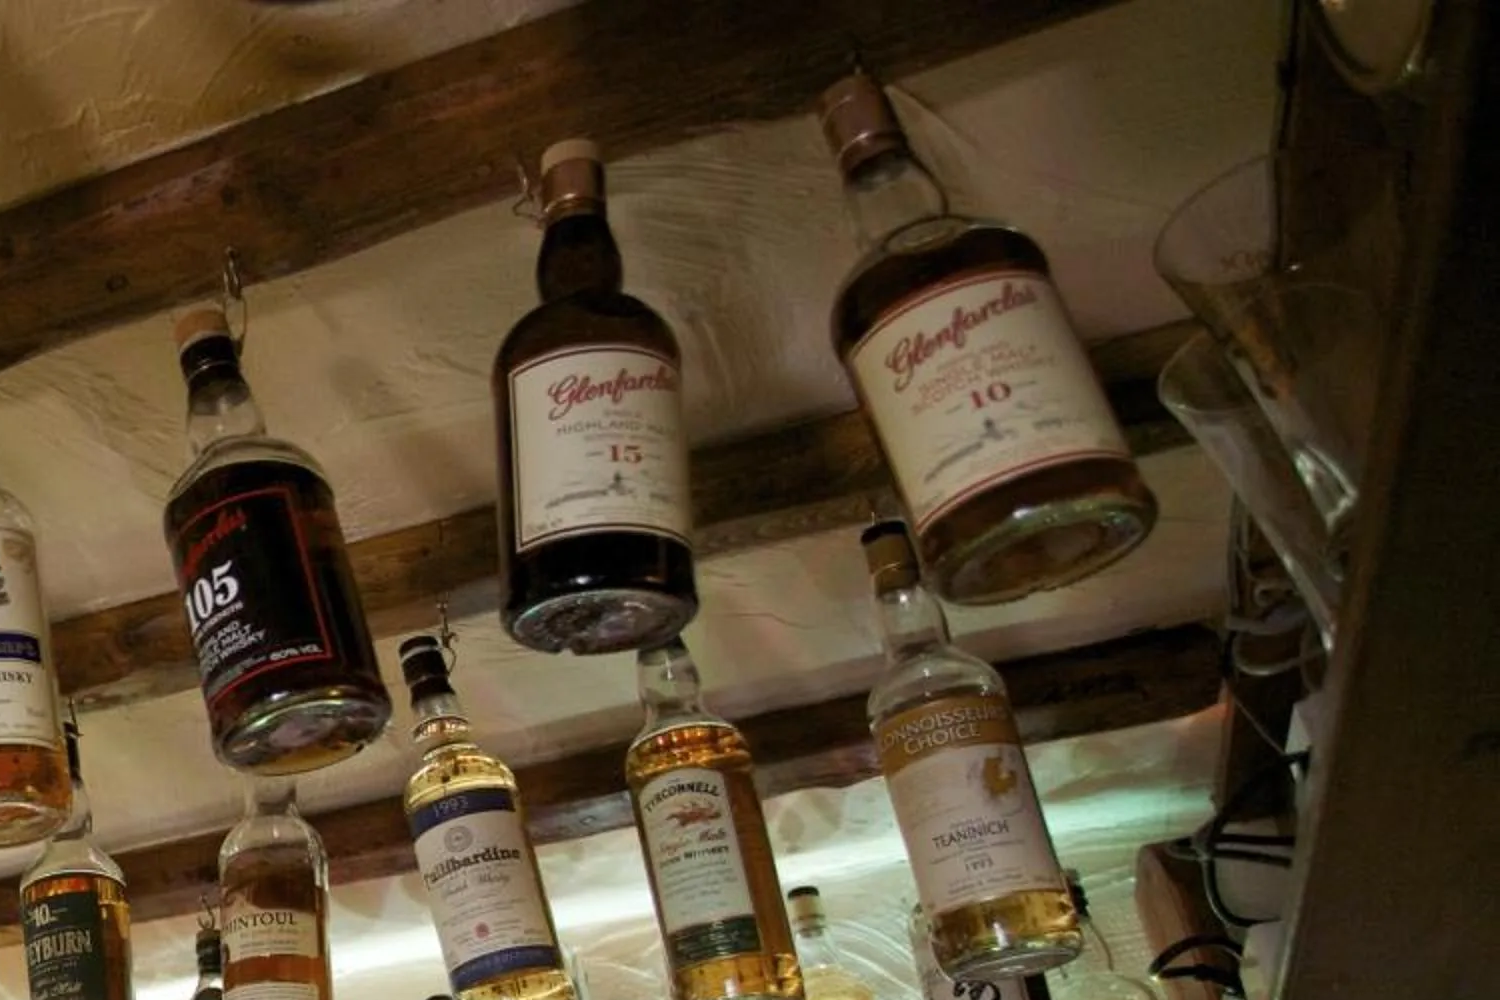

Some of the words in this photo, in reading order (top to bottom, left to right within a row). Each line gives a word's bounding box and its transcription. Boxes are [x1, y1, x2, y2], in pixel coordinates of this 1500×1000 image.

[885, 281, 1038, 392] Glenfarclas
[547, 364, 677, 420] Glenfarcl
[970, 382, 1012, 410] 10
[609, 443, 642, 465] 15
[185, 559, 240, 631] 105
[882, 704, 1006, 751] ONNOISSEURS
[904, 721, 981, 754] CHOICE
[643, 779, 722, 812] TYRCONNELL
[931, 819, 1010, 849] TEANINICH
[424, 845, 521, 891] Tullibardine
[33, 903, 49, 927] 10
[221, 911, 298, 934] MINTOUL
[28, 929, 92, 966] EYBURN
